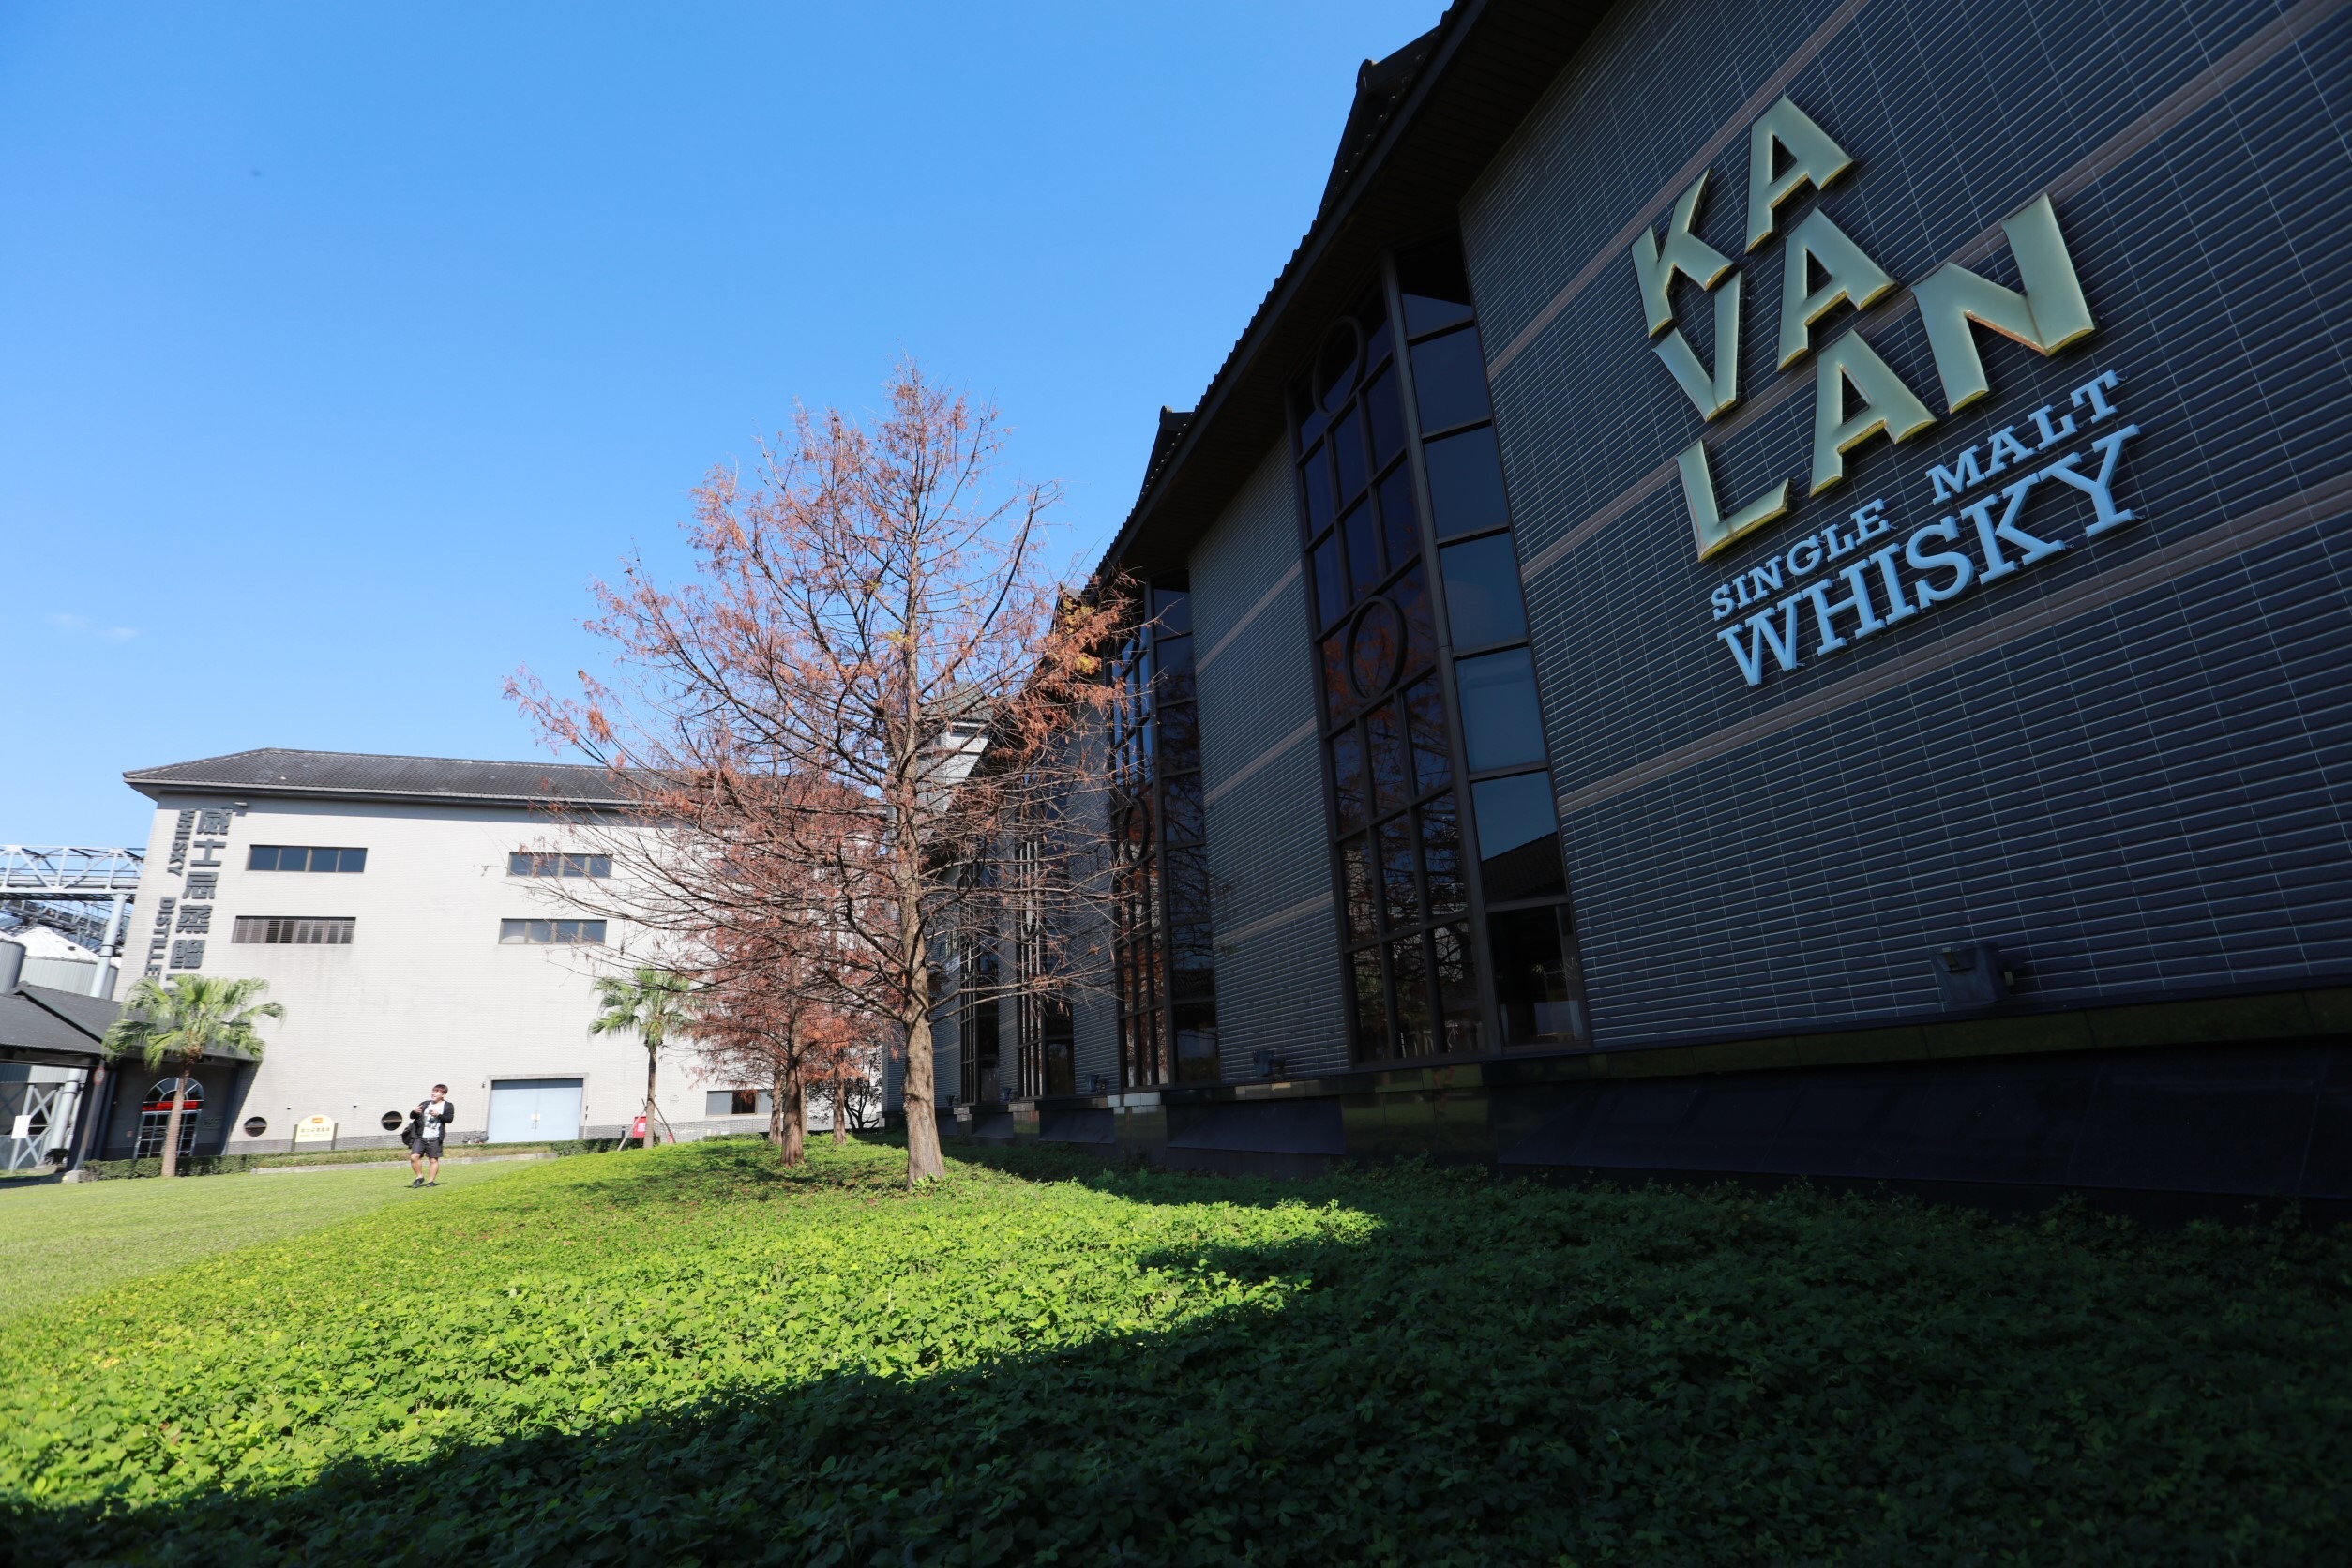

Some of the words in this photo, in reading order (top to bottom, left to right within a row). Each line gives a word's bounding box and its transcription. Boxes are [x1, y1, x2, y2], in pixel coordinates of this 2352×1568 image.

[1711, 497, 1893, 622] SINGLE
[1924, 368, 2127, 506] MALT
[1716, 424, 2144, 688] WHISKY
[163, 807, 233, 995] 威士忌蒸餾
[167, 809, 196, 877] WHISKY
